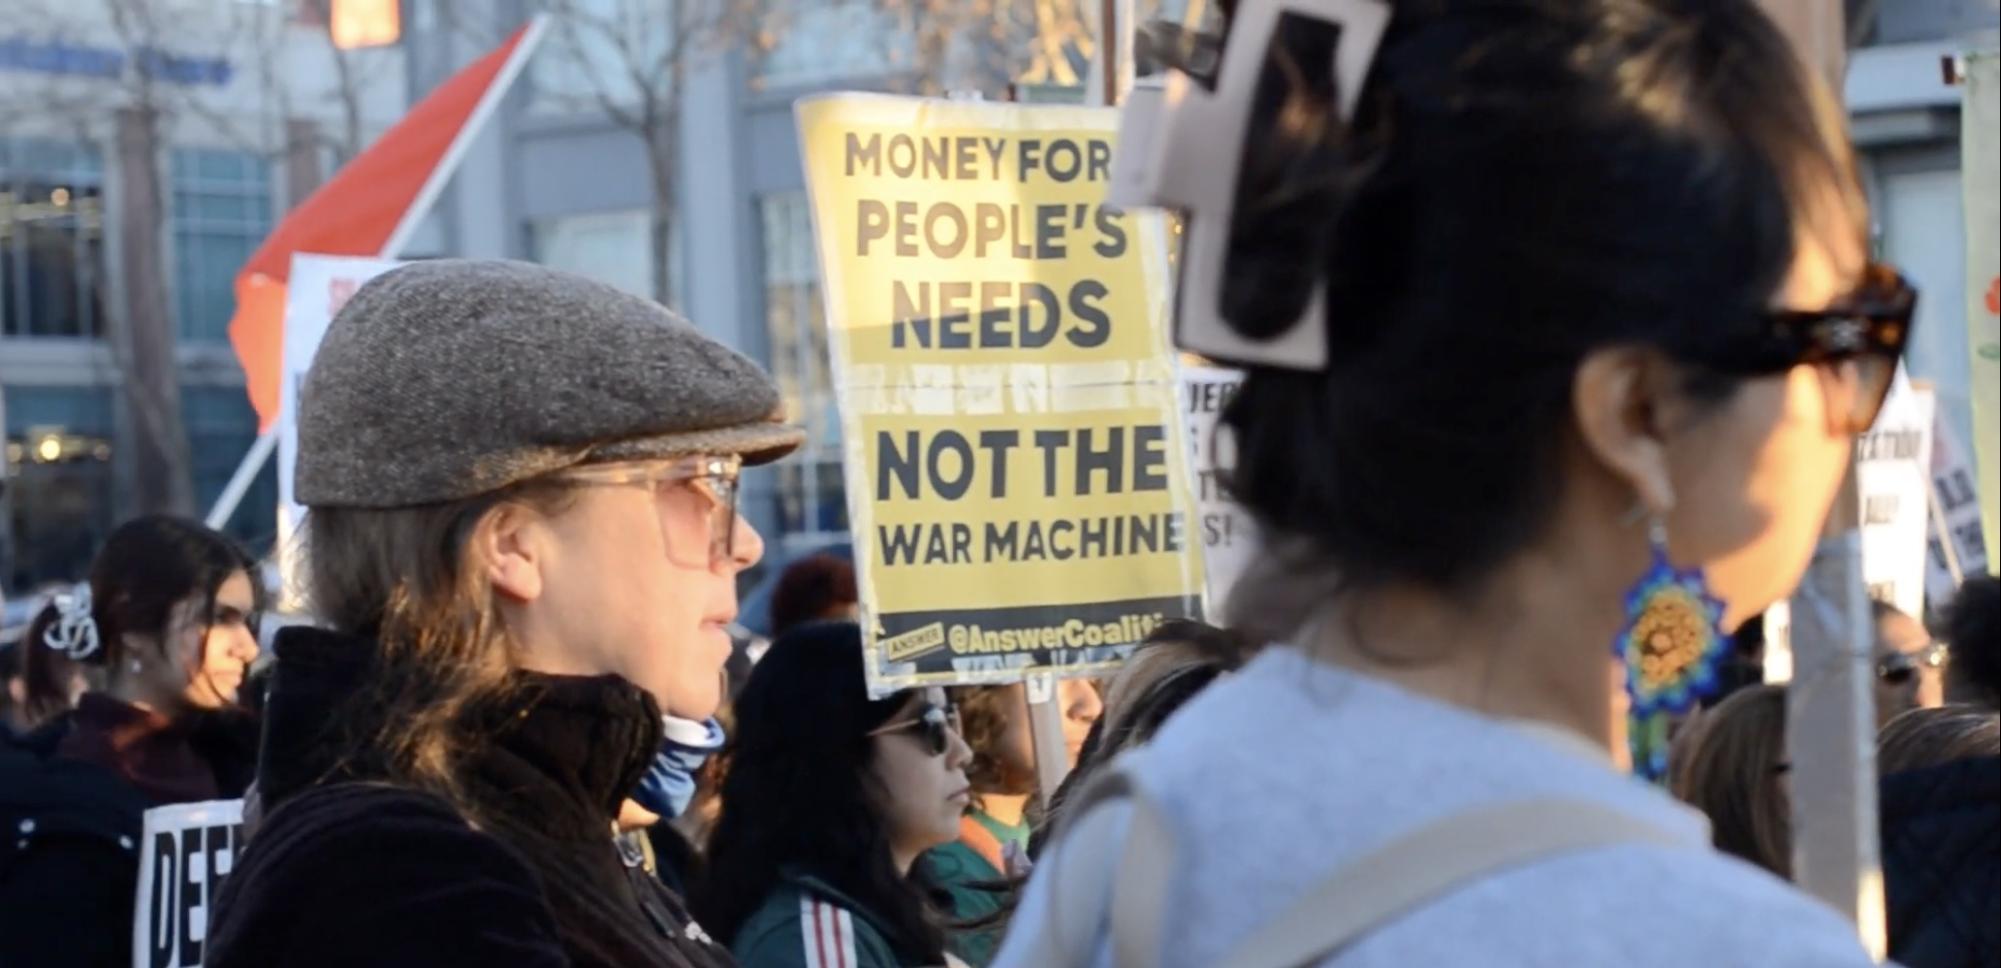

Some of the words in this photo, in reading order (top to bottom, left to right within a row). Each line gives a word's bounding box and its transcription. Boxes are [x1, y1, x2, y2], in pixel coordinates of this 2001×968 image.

[844, 132, 1006, 182] MONEY
[1018, 138, 1112, 183] FOR
[855, 199, 1127, 260] PEOPLE'S
[891, 278, 1112, 349] NEEDS
[876, 428, 1019, 501] NOT
[1034, 424, 1168, 497] THE
[878, 521, 973, 567] WAR
[984, 512, 1184, 565] MACHINE
